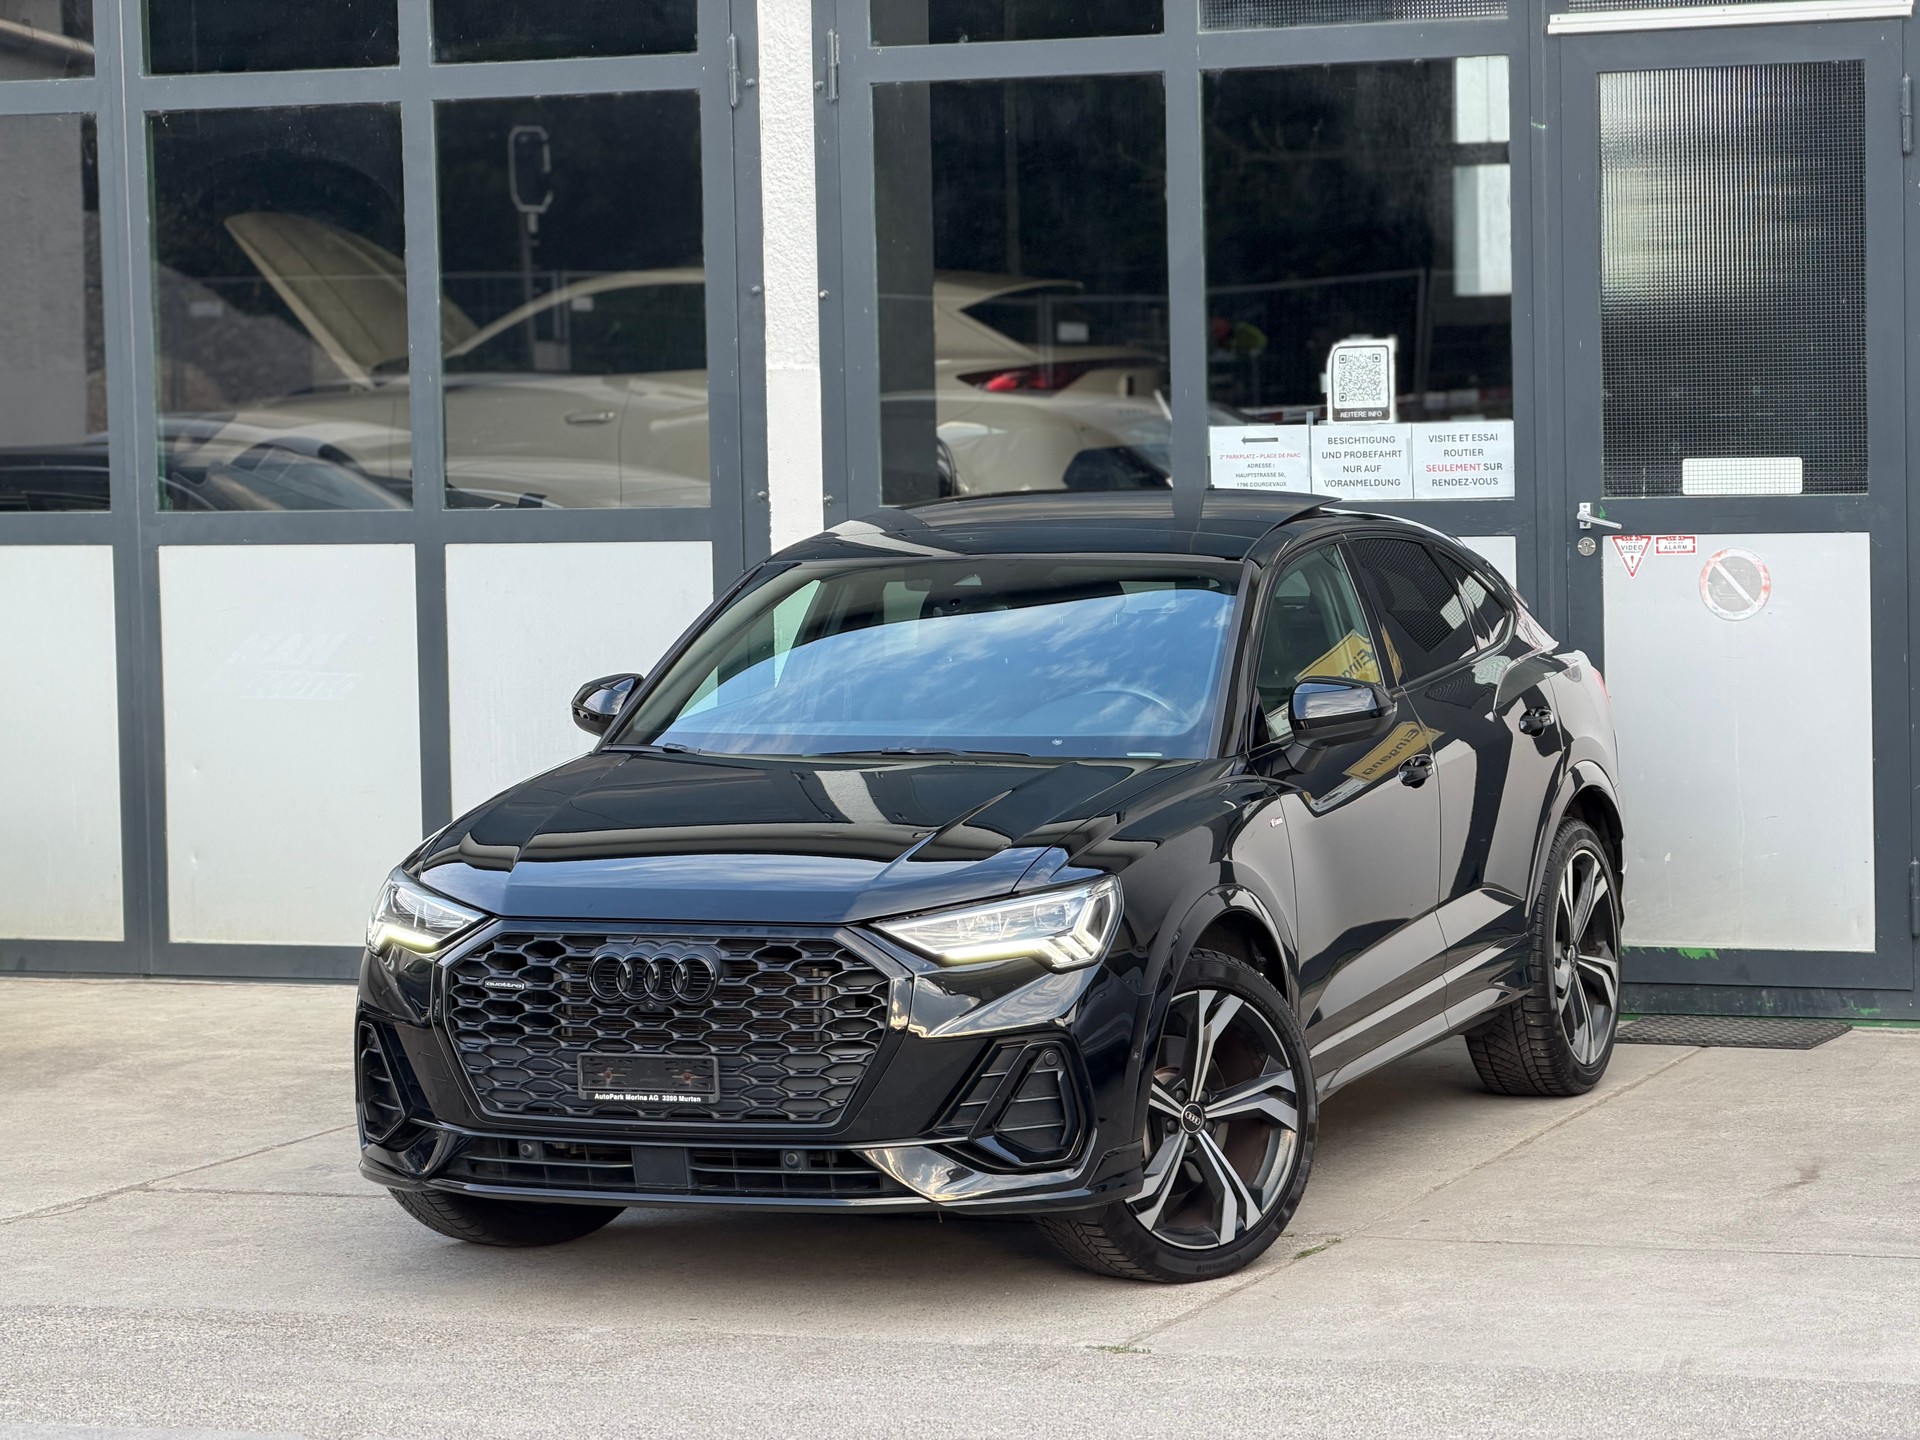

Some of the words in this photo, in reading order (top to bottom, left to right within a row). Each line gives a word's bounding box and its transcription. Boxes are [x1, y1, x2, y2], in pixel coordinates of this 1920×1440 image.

[1327, 436, 1396, 445] BESICHTIGUNG
[1428, 435, 1457, 443] VISITE
[1459, 434, 1470, 442] ET
[1472, 433, 1498, 442] ESSAI
[1321, 451, 1342, 459] UND
[1343, 450, 1402, 459] PROBEFAHRT
[1443, 449, 1484, 457] ROUTIER
[1342, 465, 1362, 473] NUR
[1364, 465, 1382, 473] AUF
[1426, 464, 1481, 472] SEULEMENT
[1483, 463, 1503, 471] SUR
[1324, 479, 1401, 487] VORANMELDUNG
[1432, 478, 1498, 487] RENDEZ-VOUS
